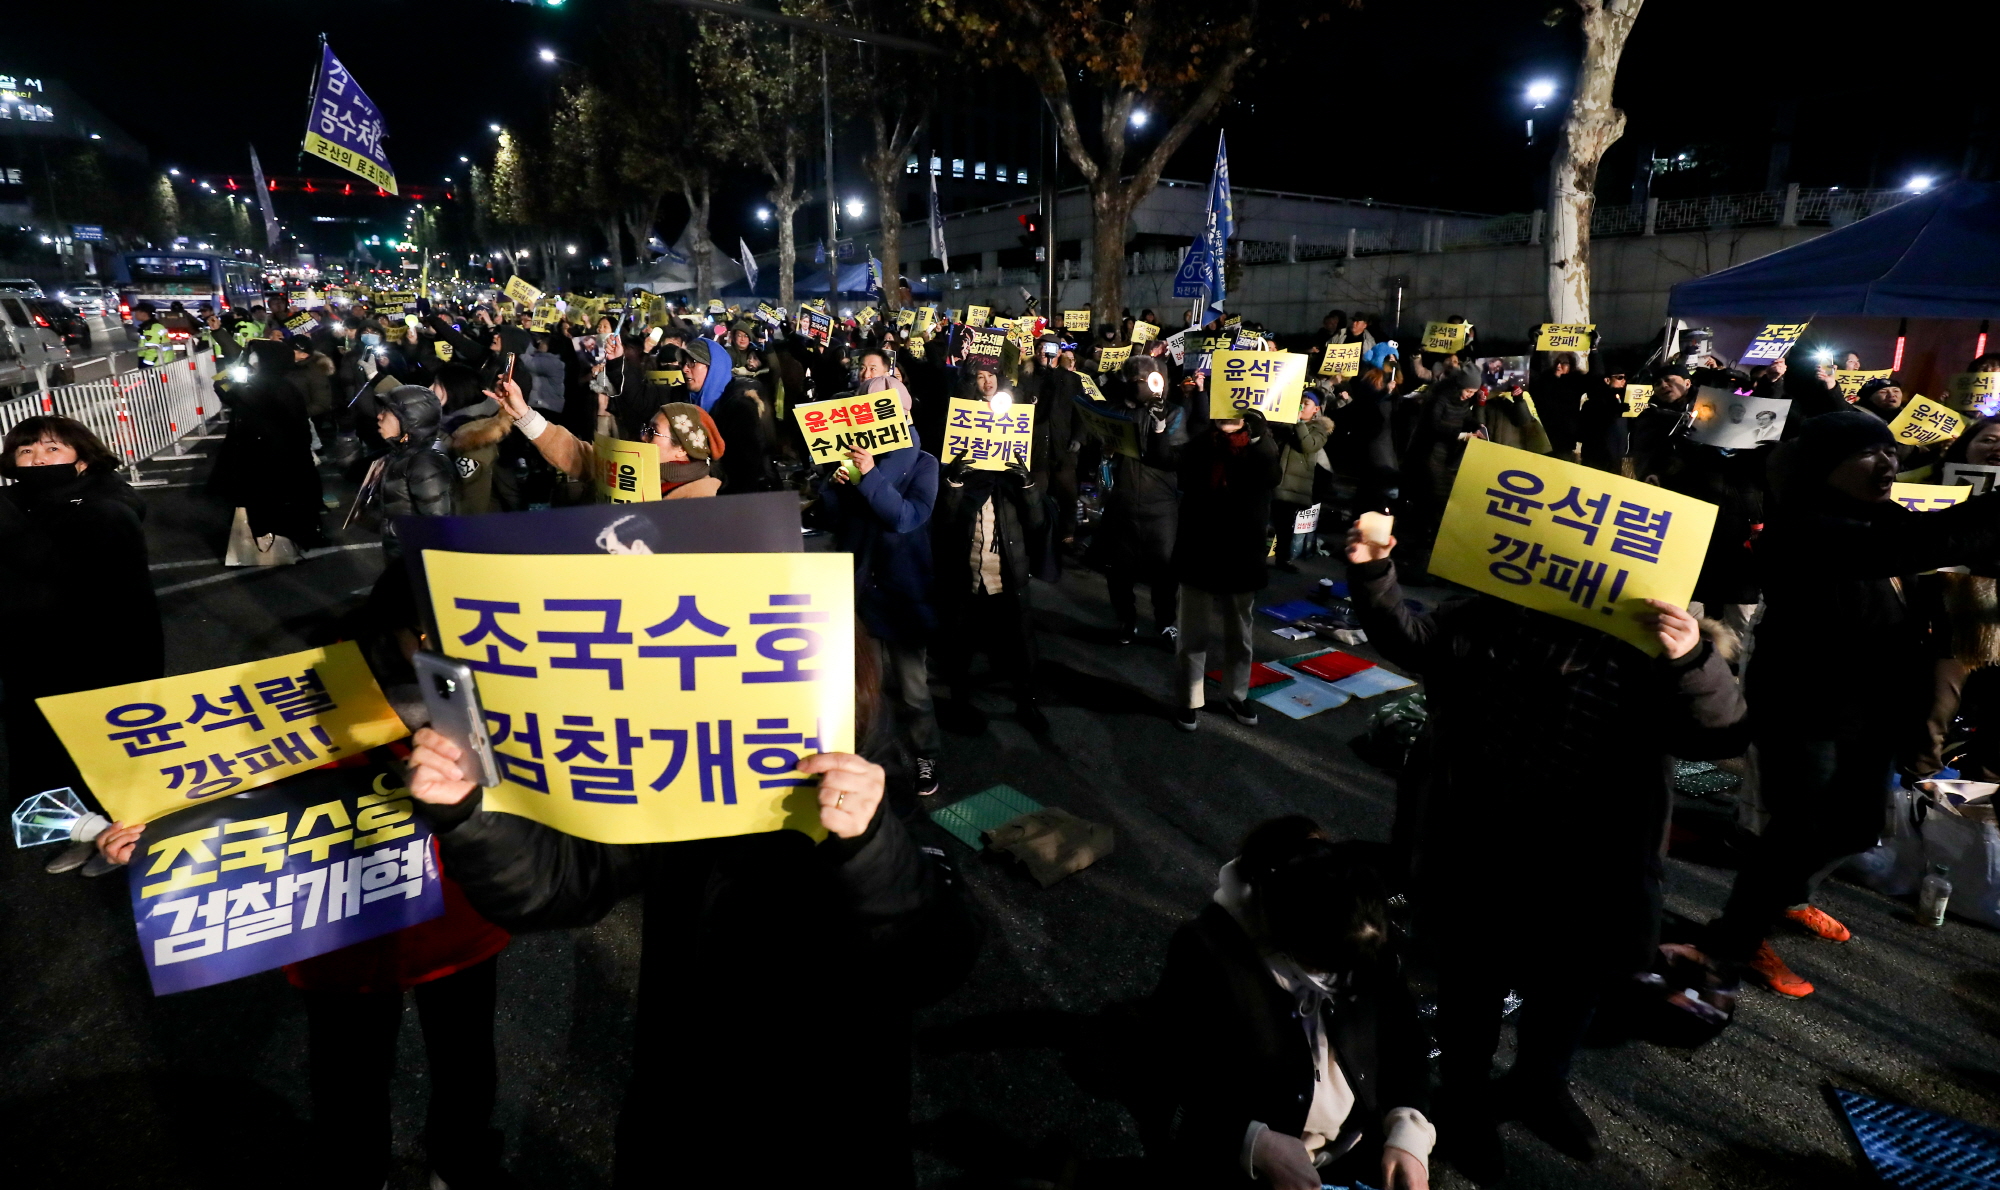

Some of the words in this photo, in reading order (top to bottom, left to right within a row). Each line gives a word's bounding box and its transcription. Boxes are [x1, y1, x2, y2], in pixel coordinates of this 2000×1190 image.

[317, 140, 352, 168] 군산의
[1429, 325, 1458, 338] 윤석렬
[1429, 338, 1453, 350] 깡패!
[1547, 325, 1587, 334] 윤석렬
[1549, 335, 1579, 347] 깡패!
[969, 343, 1002, 357] 설치하라
[1326, 347, 1360, 359] 조국수호
[1323, 360, 1359, 372] 검찰개혁
[804, 398, 897, 434] 윤석열을
[949, 407, 1031, 435] 조국수호
[1910, 403, 1959, 434] 윤석렬
[811, 421, 909, 458] 수사하라!
[948, 433, 1030, 463] 검찰개혁
[1900, 422, 1942, 444] 깡패!
[1485, 469, 1673, 564] 윤석렬
[1487, 533, 1629, 616] 깡패!
[453, 593, 829, 692] 조국수호
[105, 668, 338, 758] 윤석렬
[160, 726, 341, 800] 깡패!
[140, 773, 416, 900] 조국수호
[152, 838, 425, 968] 검찰개혁
